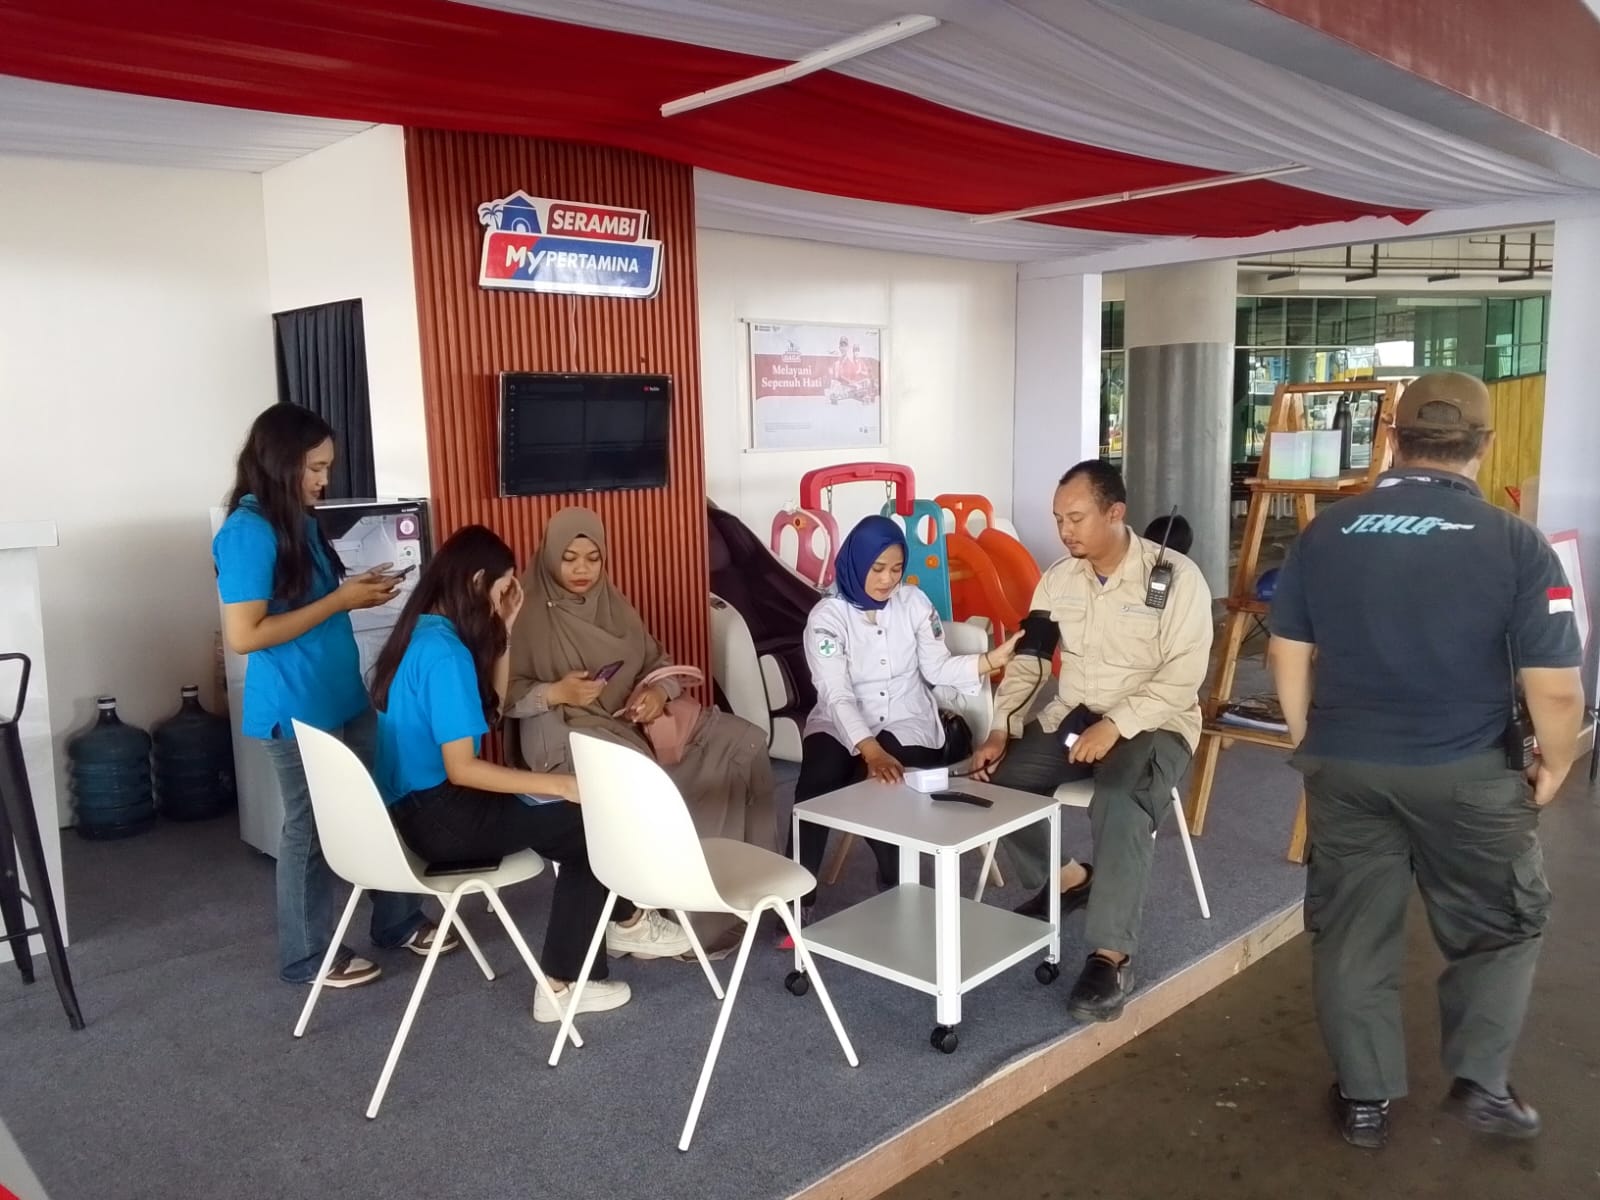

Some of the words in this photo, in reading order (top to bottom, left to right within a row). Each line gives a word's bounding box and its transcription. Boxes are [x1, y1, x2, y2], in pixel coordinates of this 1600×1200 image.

[552, 210, 636, 237] SERAMBI
[772, 364, 812, 378] Melayani
[761, 377, 801, 390] Sepenuh
[803, 378, 823, 388] Hati
